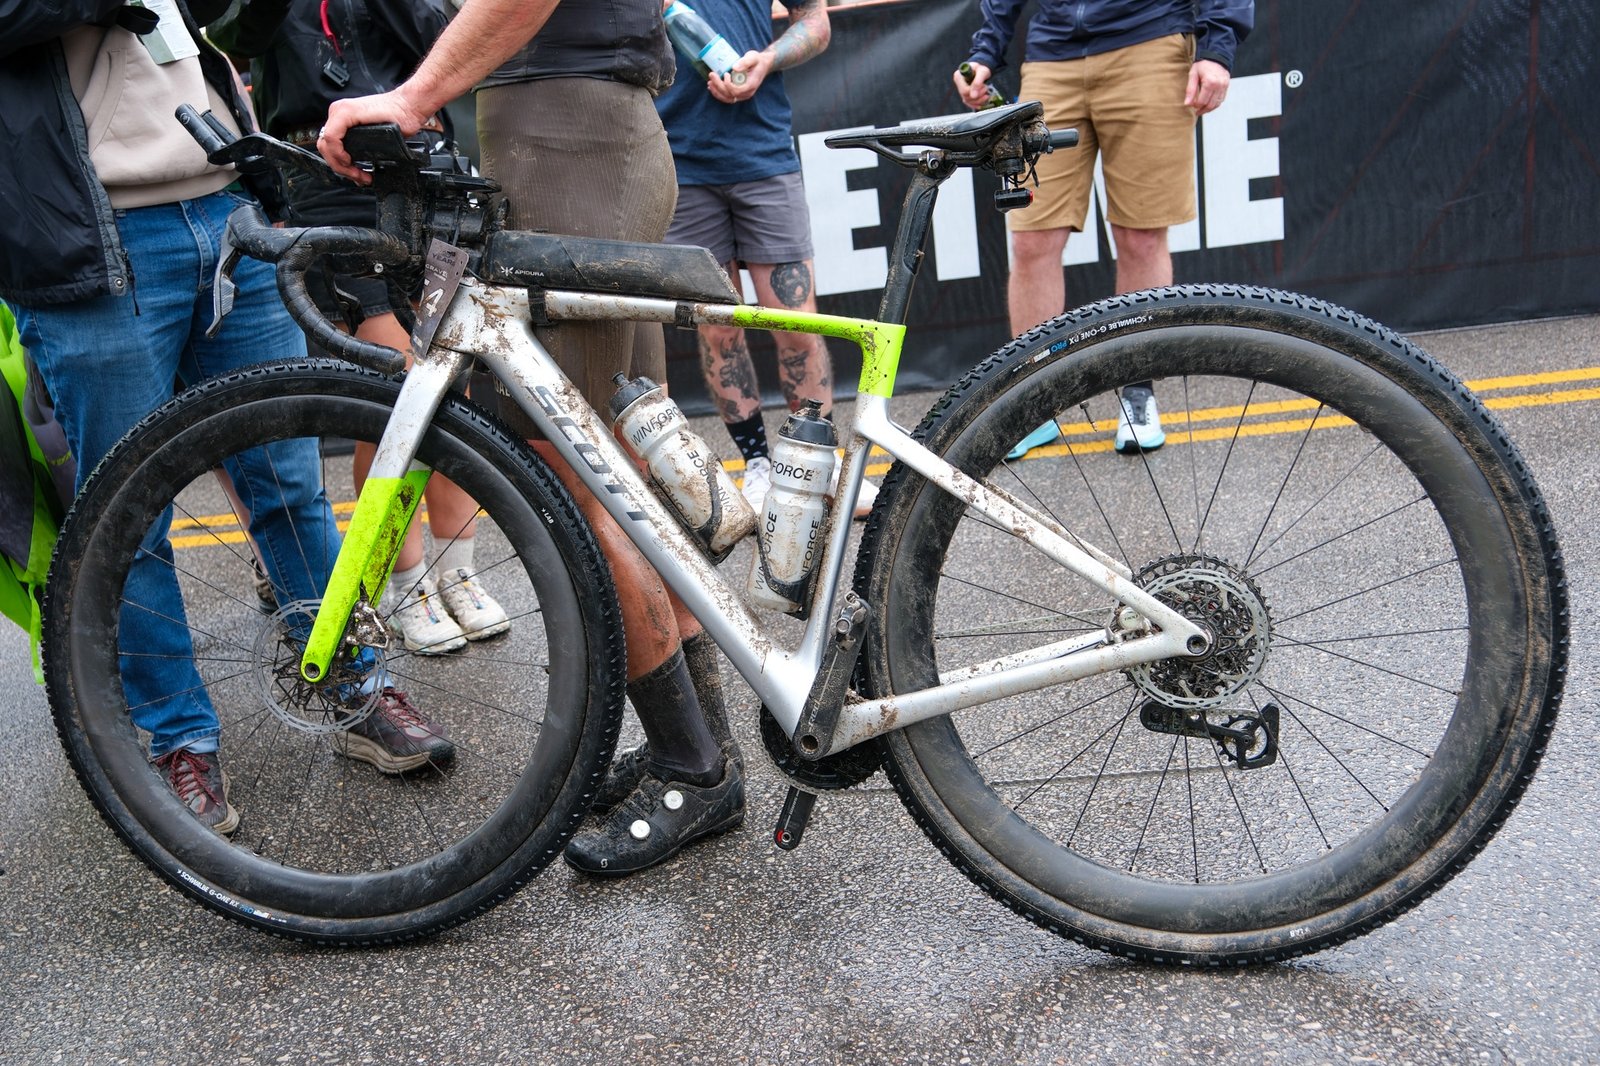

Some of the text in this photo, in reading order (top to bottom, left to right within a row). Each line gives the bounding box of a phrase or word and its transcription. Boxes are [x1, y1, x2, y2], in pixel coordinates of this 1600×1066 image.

[514, 269, 545, 277] APIDURA
[1109, 315, 1148, 330] SCHWALBE
[1081, 326, 1107, 341] G-ONE
[1051, 340, 1068, 353] PRO
[525, 385, 658, 529] SCOTT
[544, 512, 554, 524] LAB
[180, 870, 209, 893] SCHWALBE
[208, 888, 231, 904] G-ONE
[229, 900, 240, 909] RX
[239, 903, 254, 914] PRO
